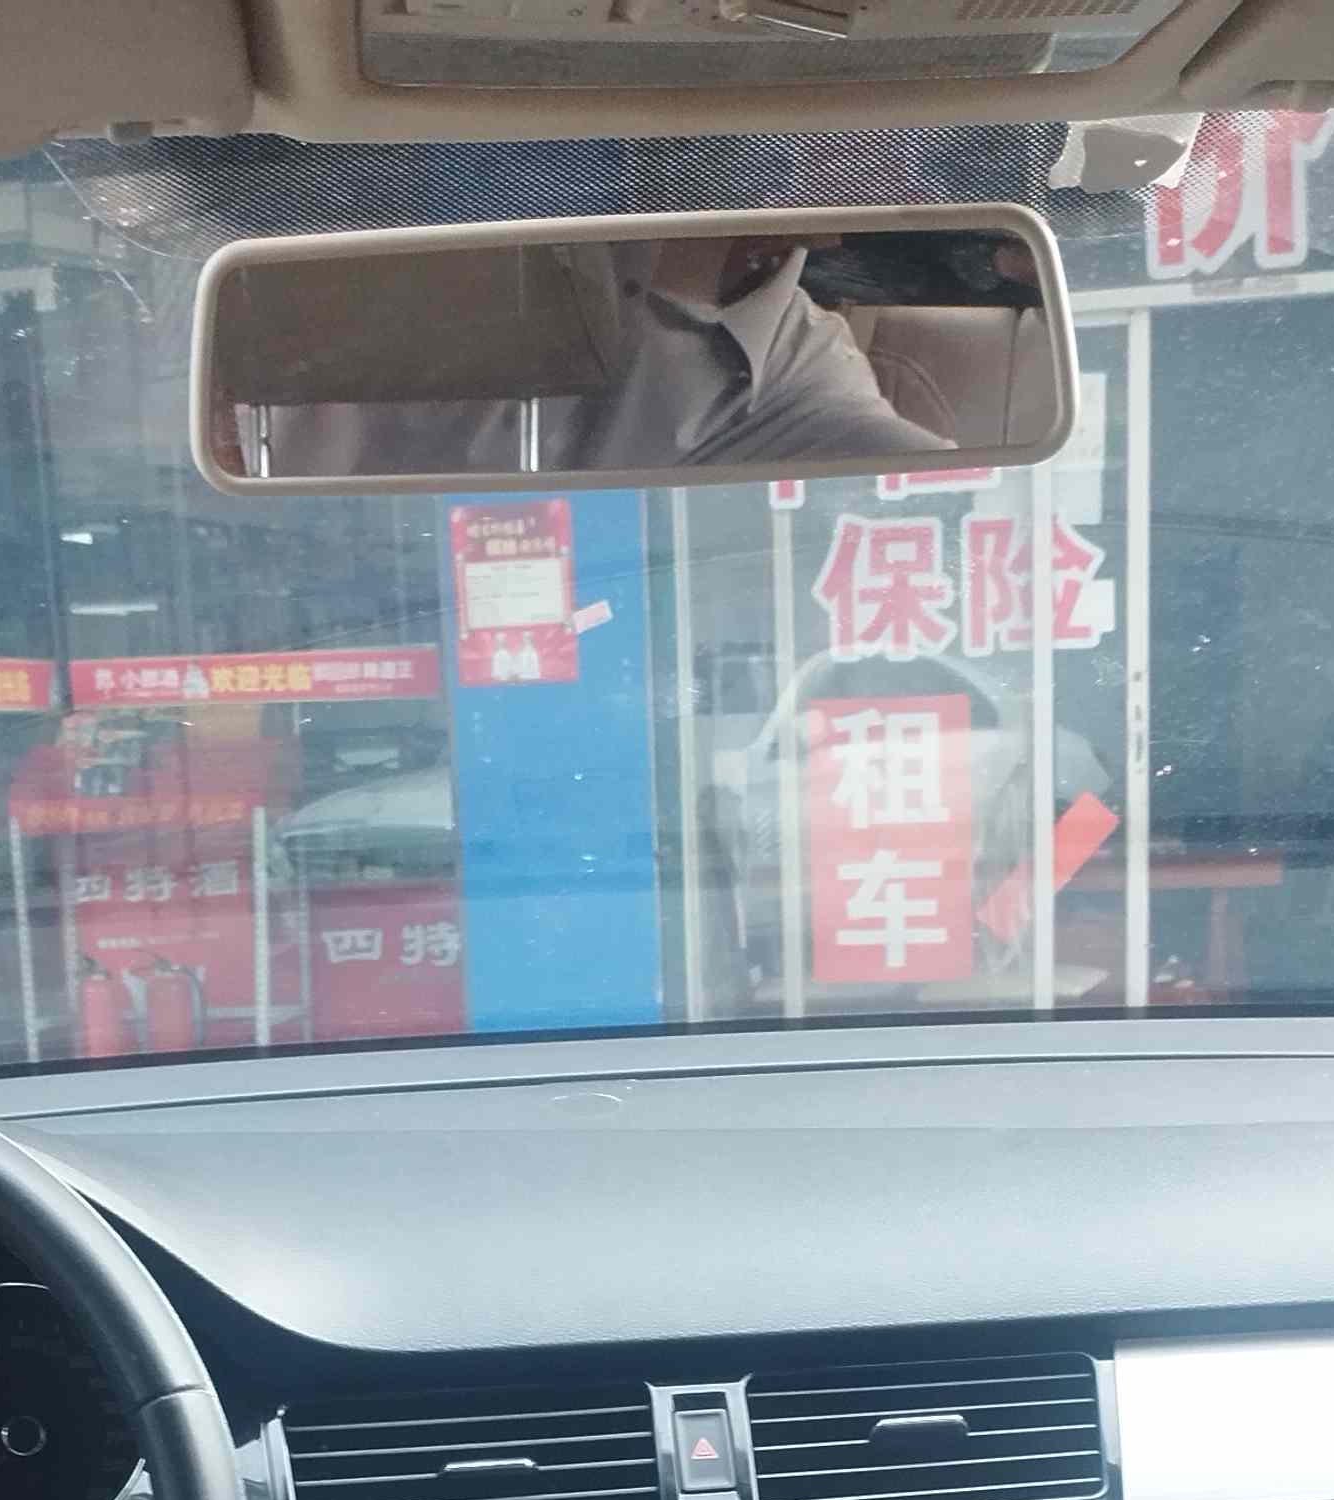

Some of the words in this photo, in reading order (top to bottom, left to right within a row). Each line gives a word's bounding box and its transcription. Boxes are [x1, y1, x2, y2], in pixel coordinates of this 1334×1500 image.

[817, 516, 1103, 655] 保险
[210, 663, 312, 695] 欢迎光临
[827, 710, 951, 968] 租车
